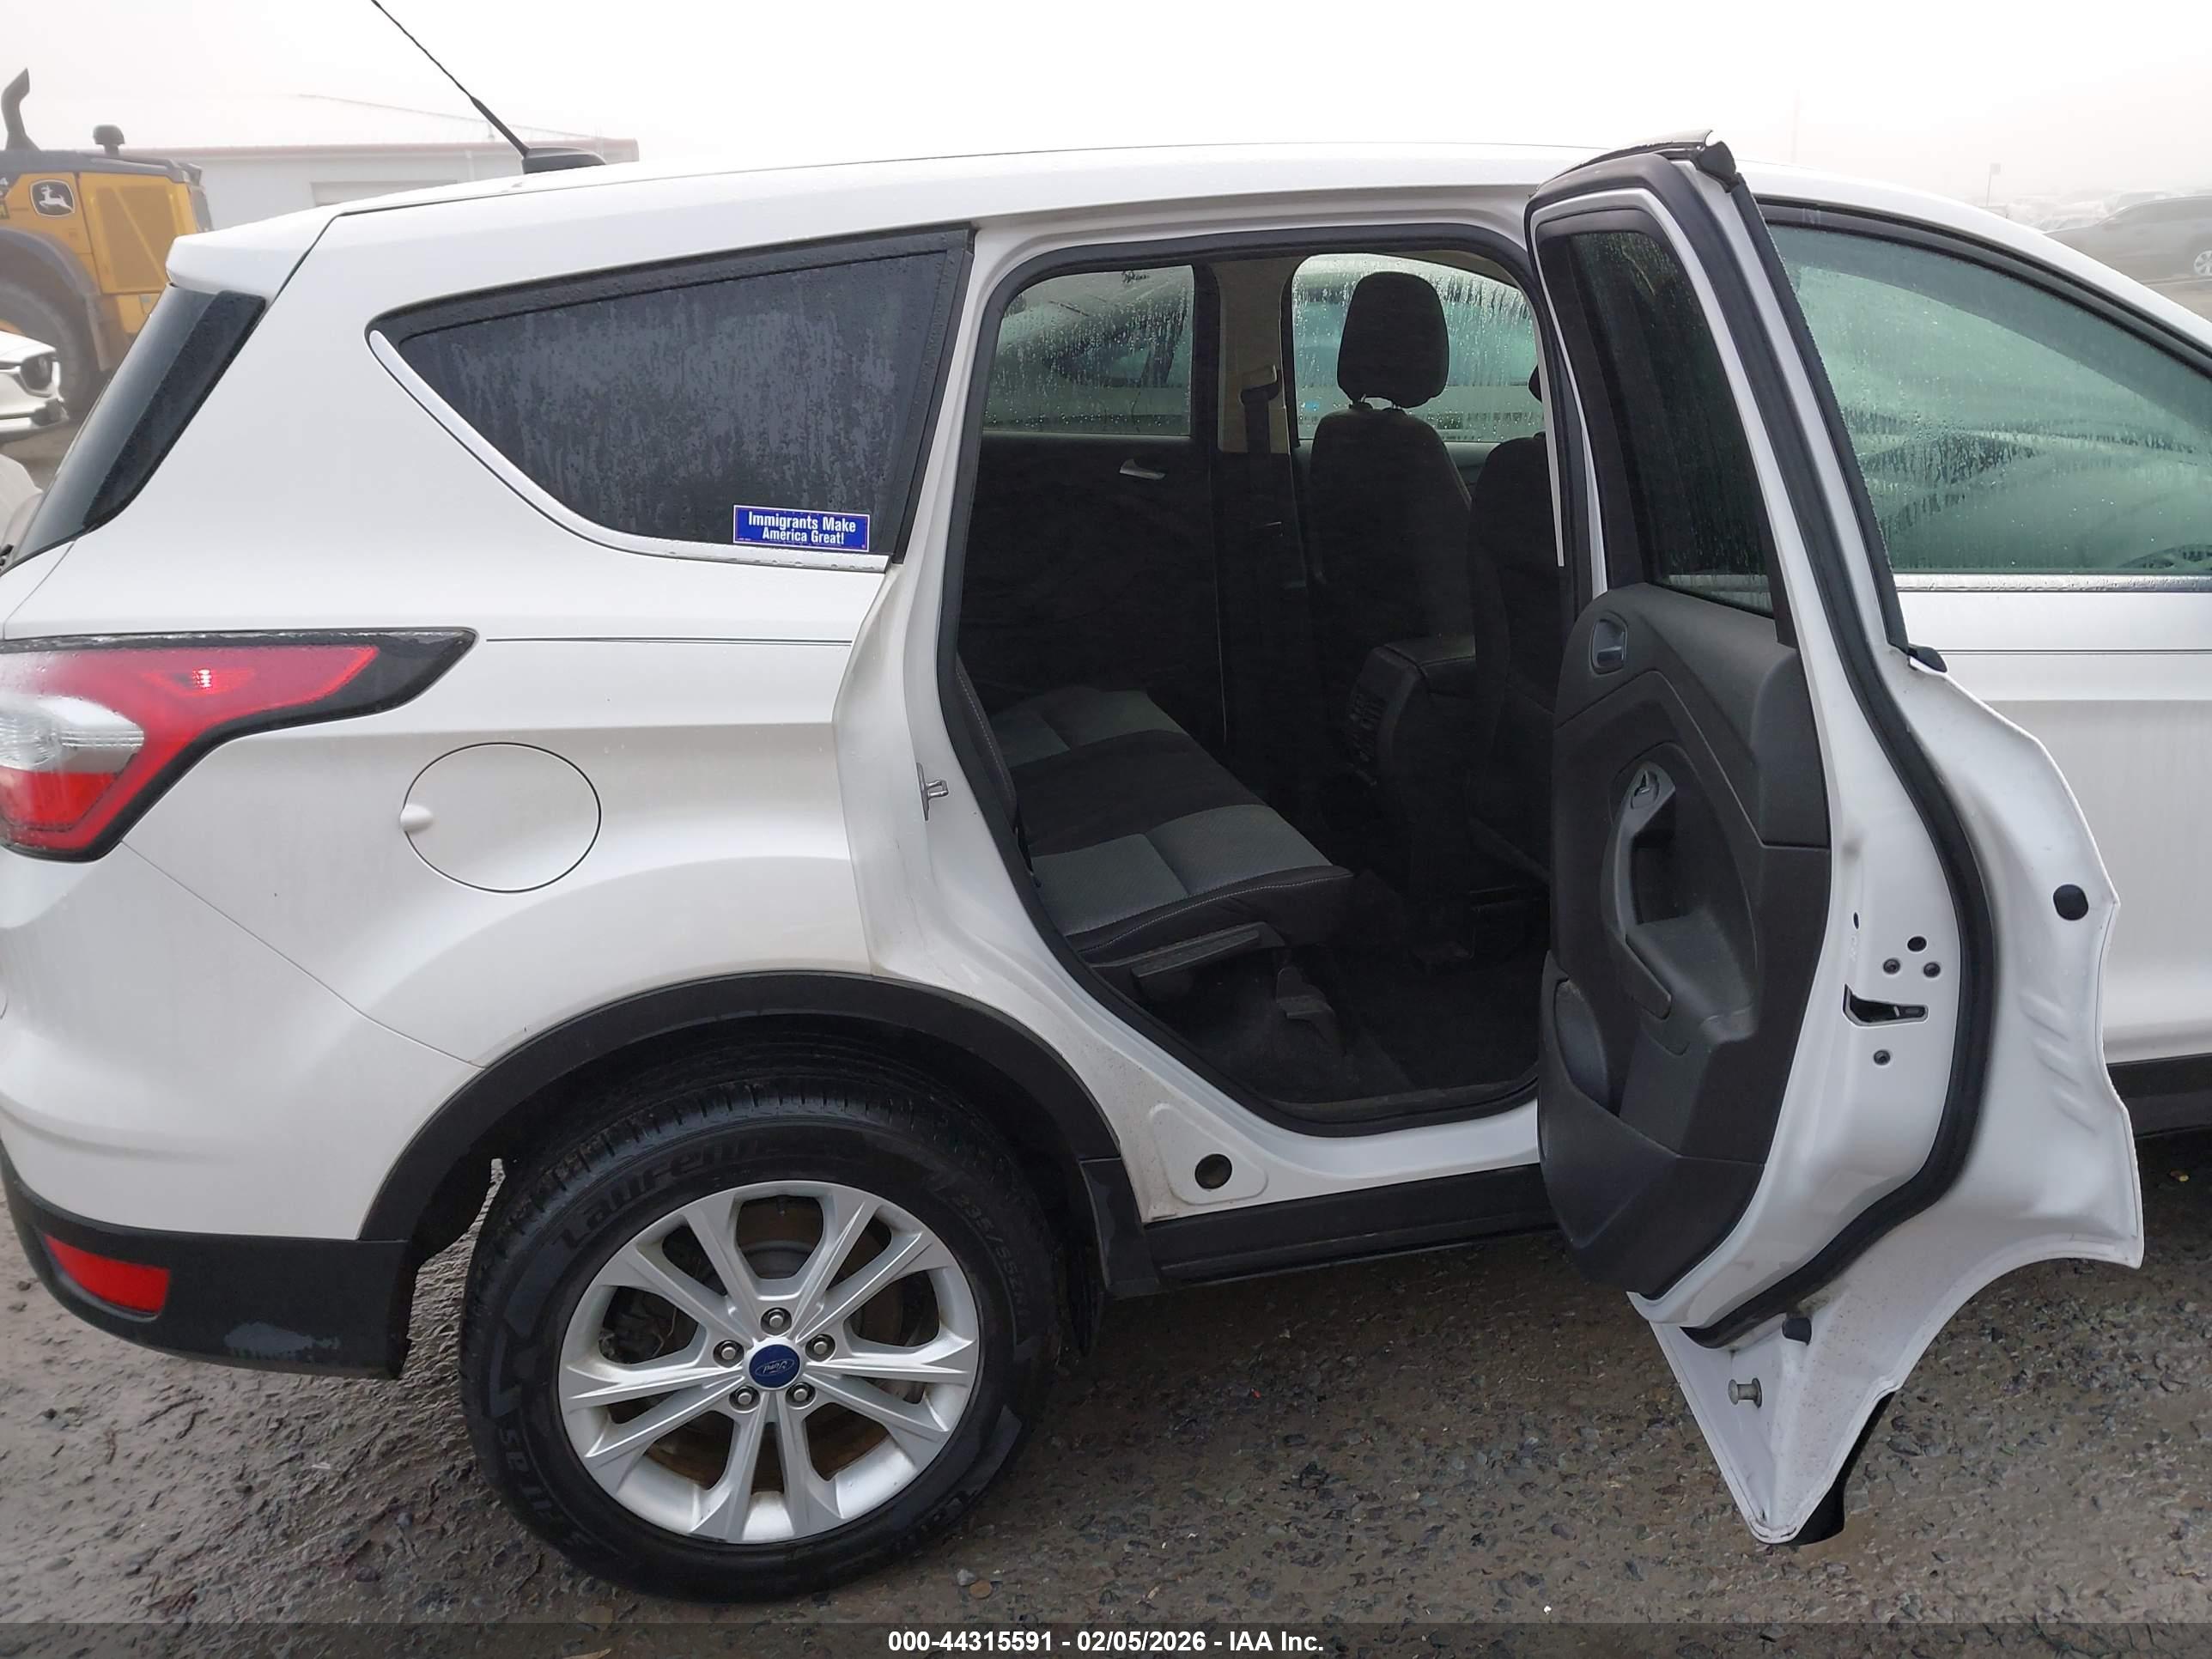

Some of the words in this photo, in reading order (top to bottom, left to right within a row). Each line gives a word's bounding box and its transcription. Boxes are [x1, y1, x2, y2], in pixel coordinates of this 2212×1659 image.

[748, 511, 818, 530] Immigrants
[822, 516, 856, 532] Make
[763, 526, 807, 542] America
[811, 530, 845, 545] Great!
[763, 1360, 787, 1374] Ford
